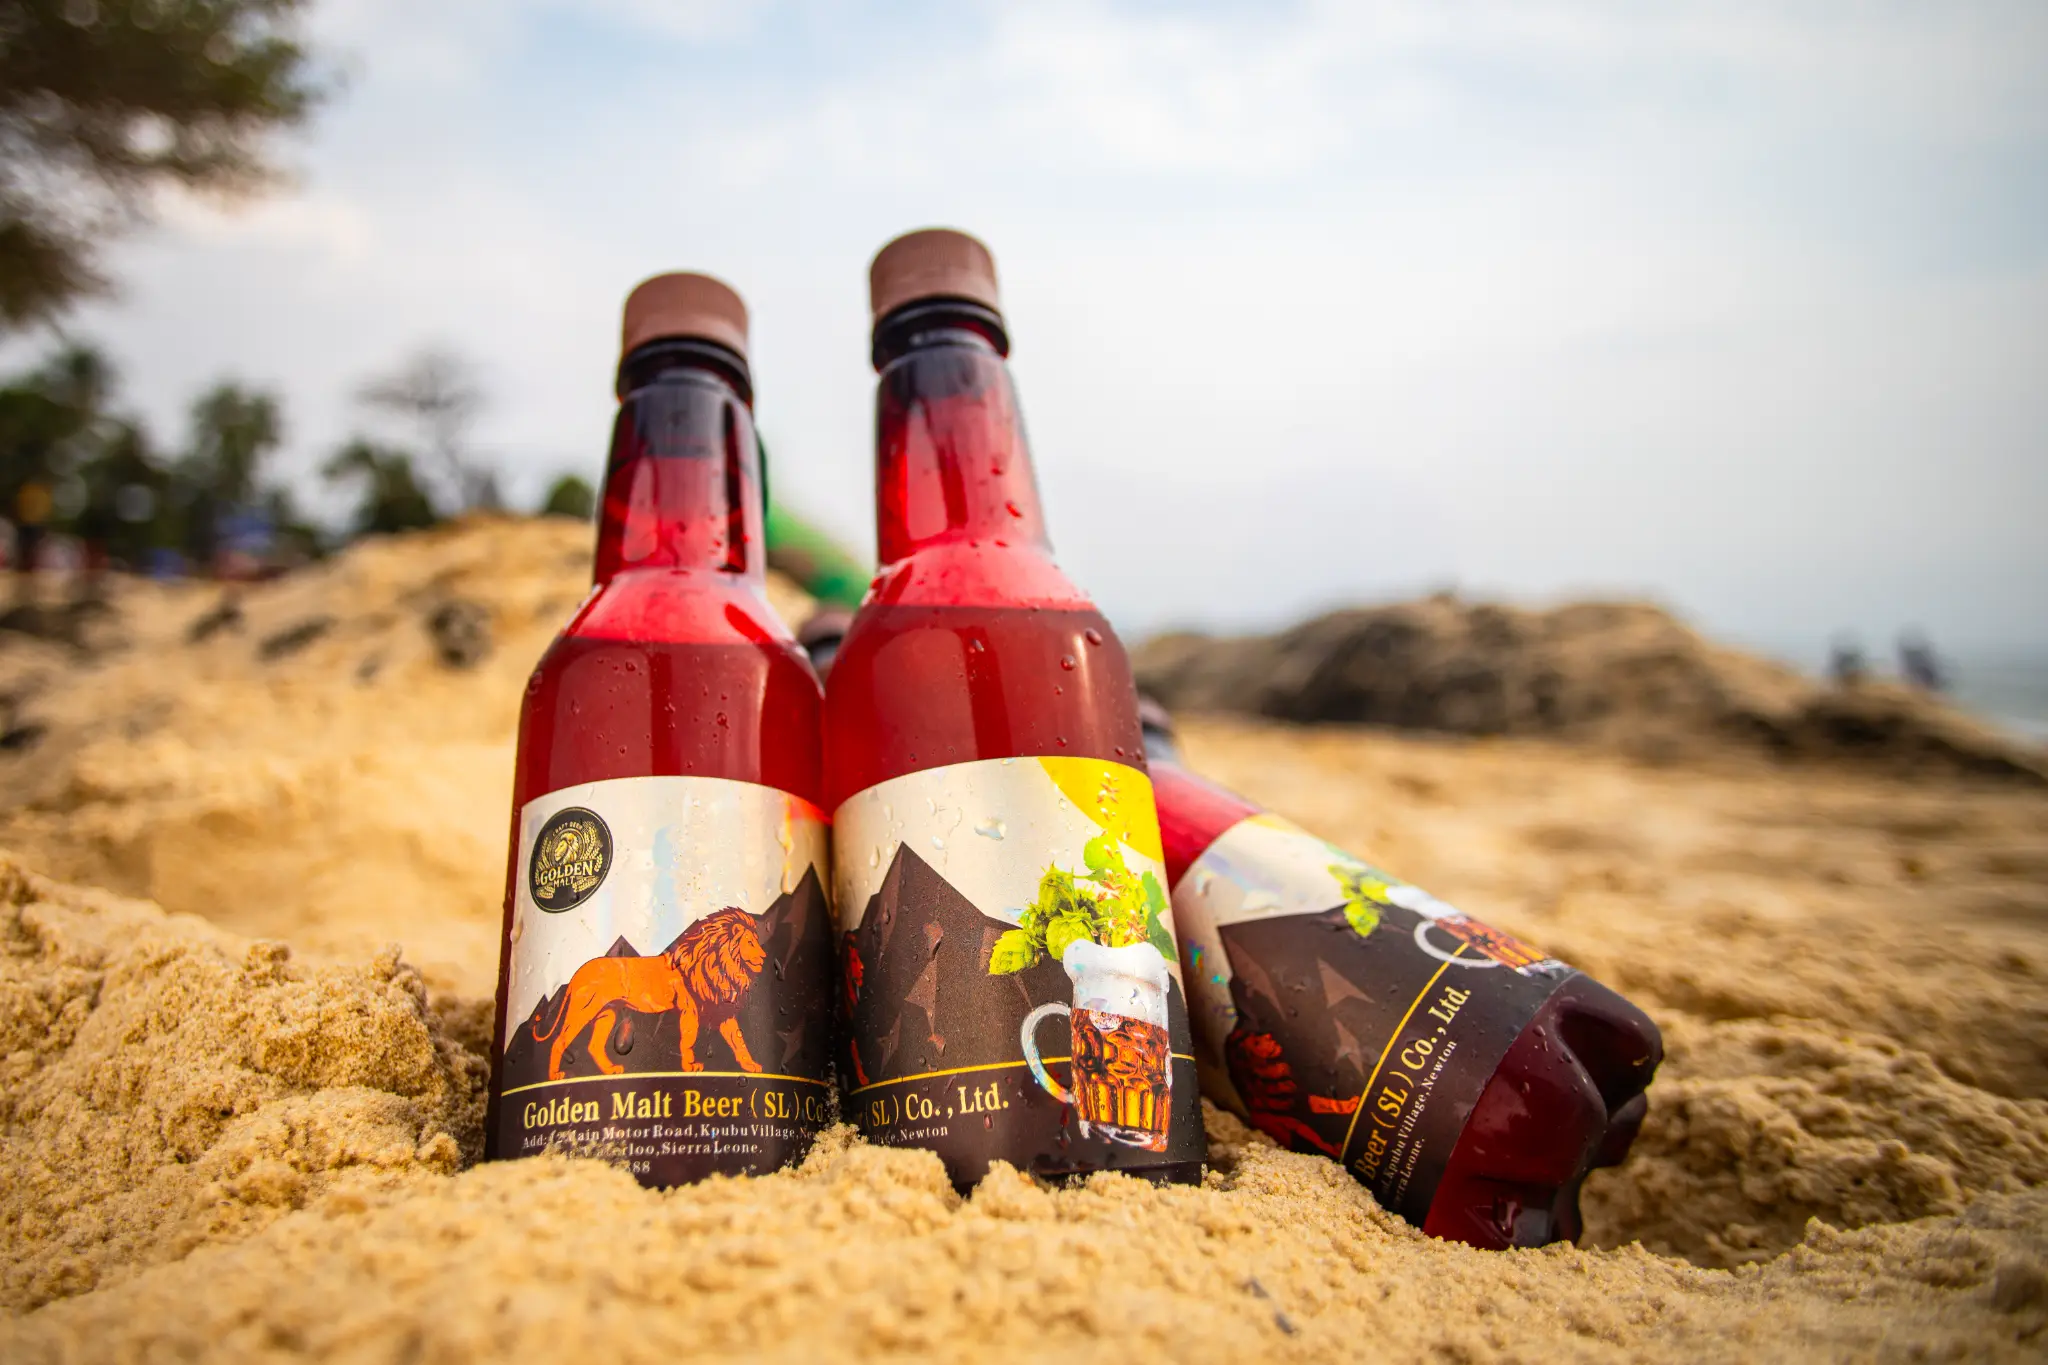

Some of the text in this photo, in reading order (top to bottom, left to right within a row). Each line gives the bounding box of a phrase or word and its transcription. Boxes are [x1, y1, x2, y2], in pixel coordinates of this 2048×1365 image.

[540, 860, 593, 885] GOLDEN
[553, 876, 576, 888] MALT
[958, 1082, 1009, 1114] Ltd.
[1355, 1128, 1388, 1181] Beer
[1428, 986, 1472, 1025] Ltd.
[523, 1096, 600, 1130] Golden
[610, 1090, 672, 1121] Malt
[682, 1089, 743, 1118] Beer
